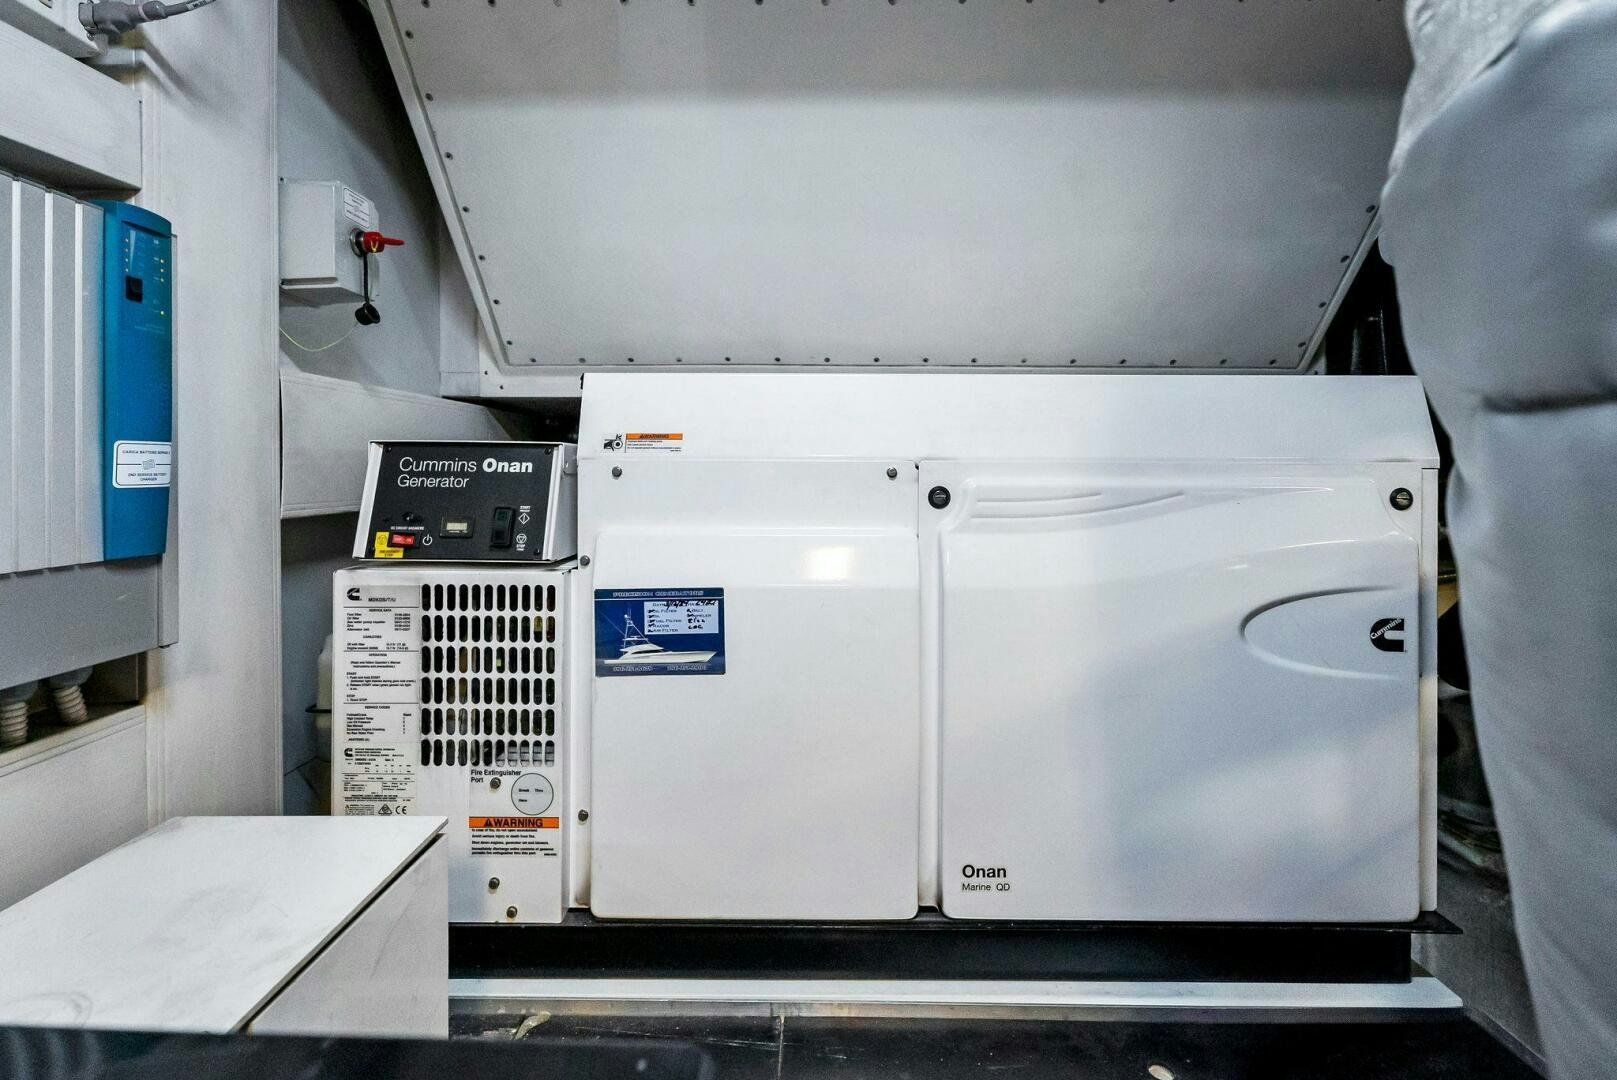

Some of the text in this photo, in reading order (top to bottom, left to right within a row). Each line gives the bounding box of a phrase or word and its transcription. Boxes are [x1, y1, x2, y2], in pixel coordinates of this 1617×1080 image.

[399, 456, 533, 473] Cummins Onan
[397, 474, 469, 488] Generator
[1370, 617, 1402, 639] Cummins
[494, 819, 543, 827] WARNING
[962, 864, 1006, 878] Onan
[996, 883, 1010, 891] QD
